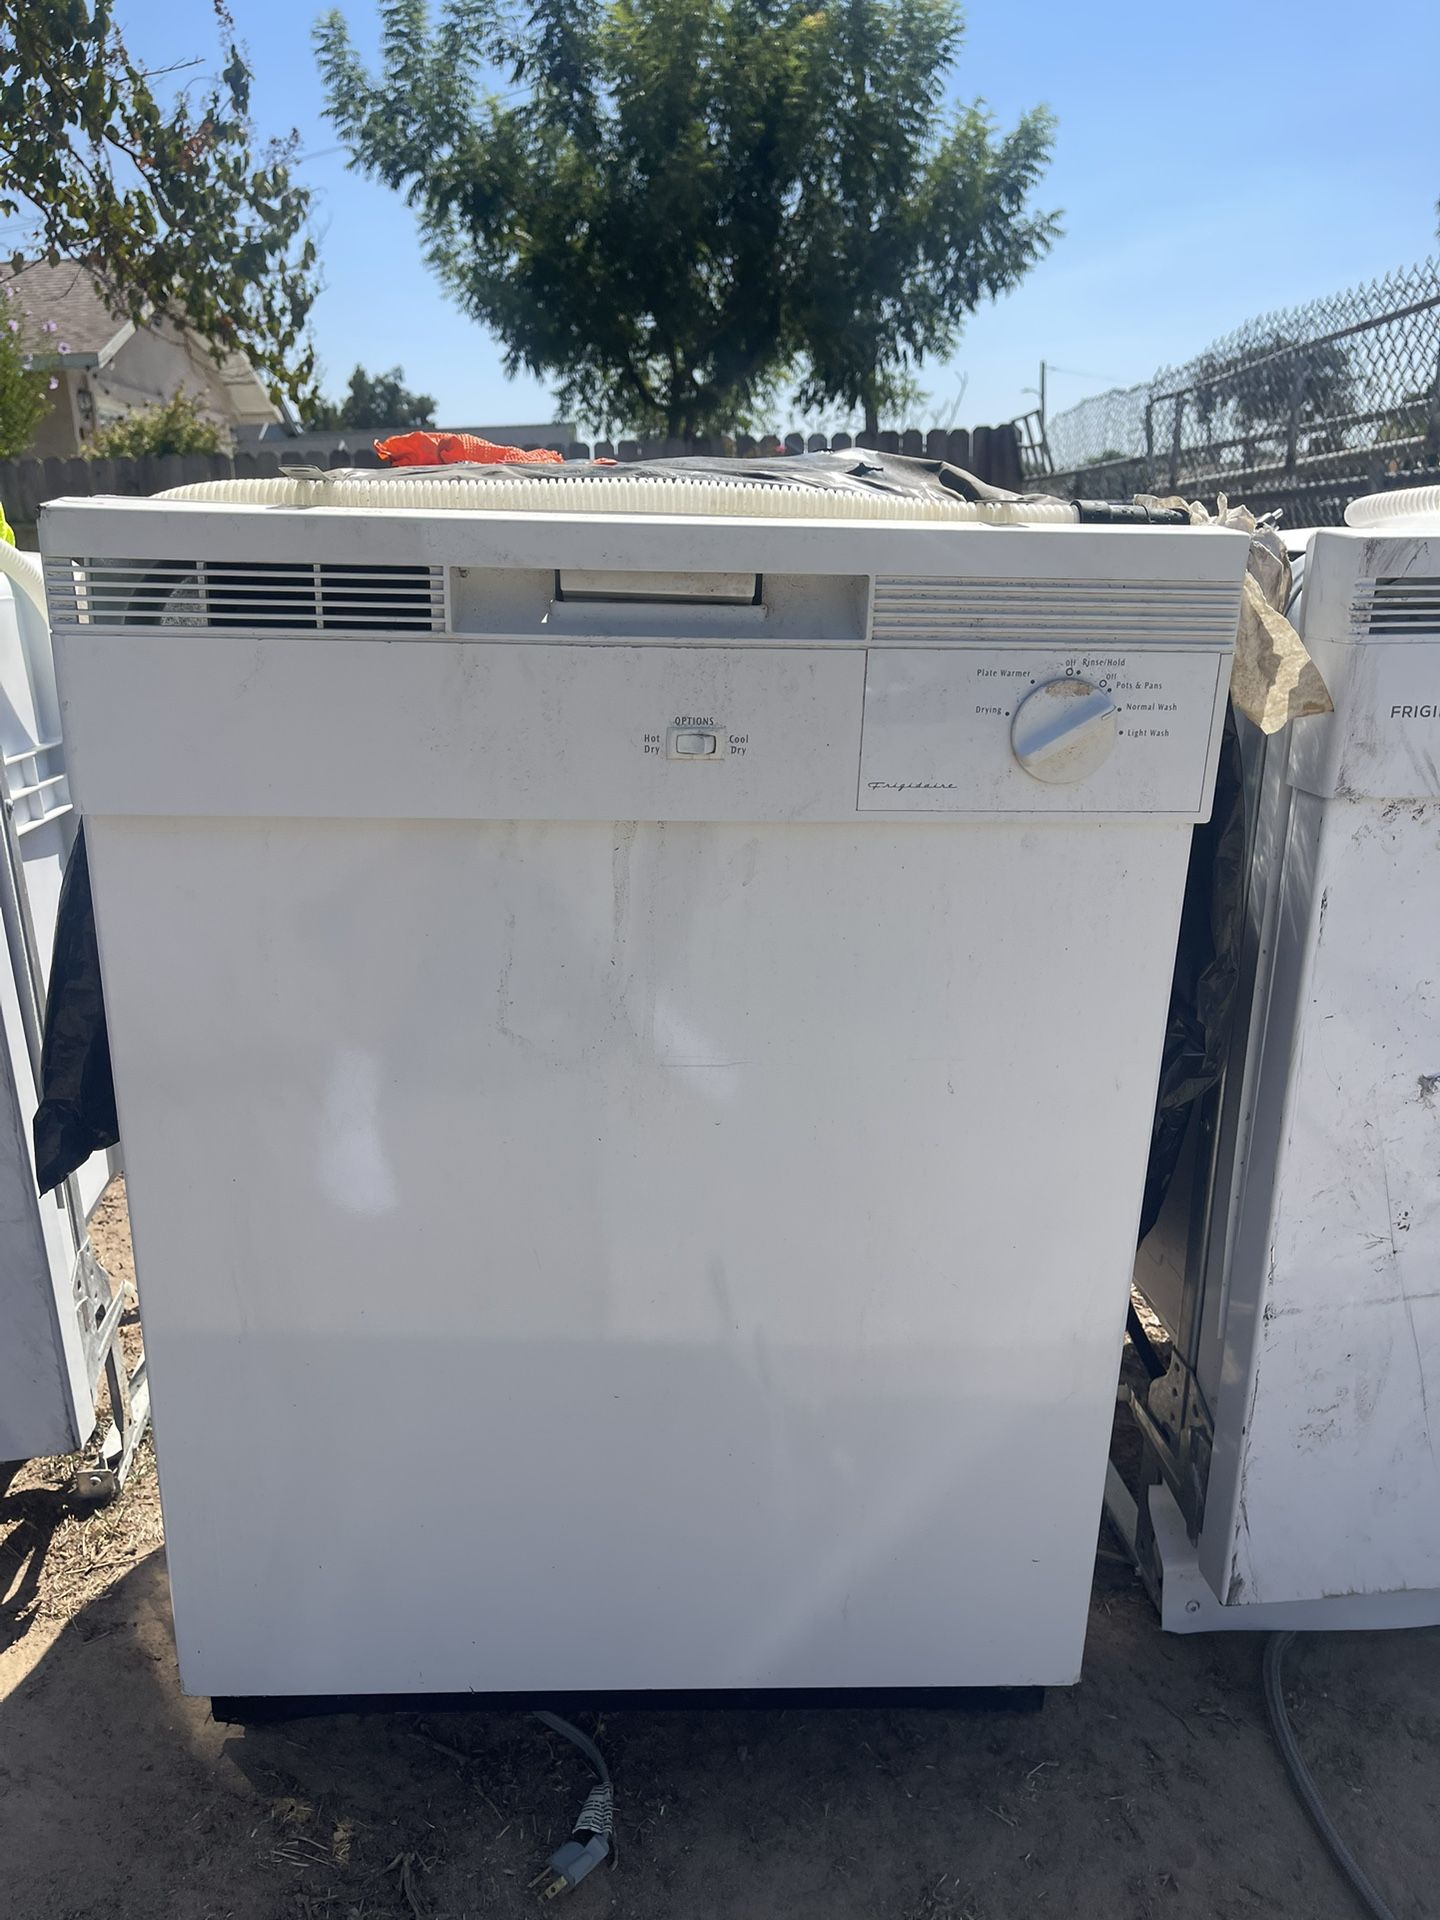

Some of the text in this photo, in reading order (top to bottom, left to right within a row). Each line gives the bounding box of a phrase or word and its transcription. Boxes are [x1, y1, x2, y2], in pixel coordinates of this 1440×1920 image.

[1082, 658, 1126, 668] Rinse/Hold
[976, 669, 1031, 678] Plate Warmer
[1116, 681, 1163, 690] Pots & Pans
[975, 705, 1002, 715] Drying
[1126, 703, 1177, 711] Normal Wash
[1391, 705, 1440, 718] FRIGI
[674, 716, 714, 725] OPTIONS
[1127, 729, 1169, 738] Light Wash
[644, 734, 660, 743] Hot
[729, 734, 749, 743] Cool
[644, 745, 660, 755] Dry
[730, 746, 746, 755] Dry
[867, 781, 958, 791] Frigidaire
